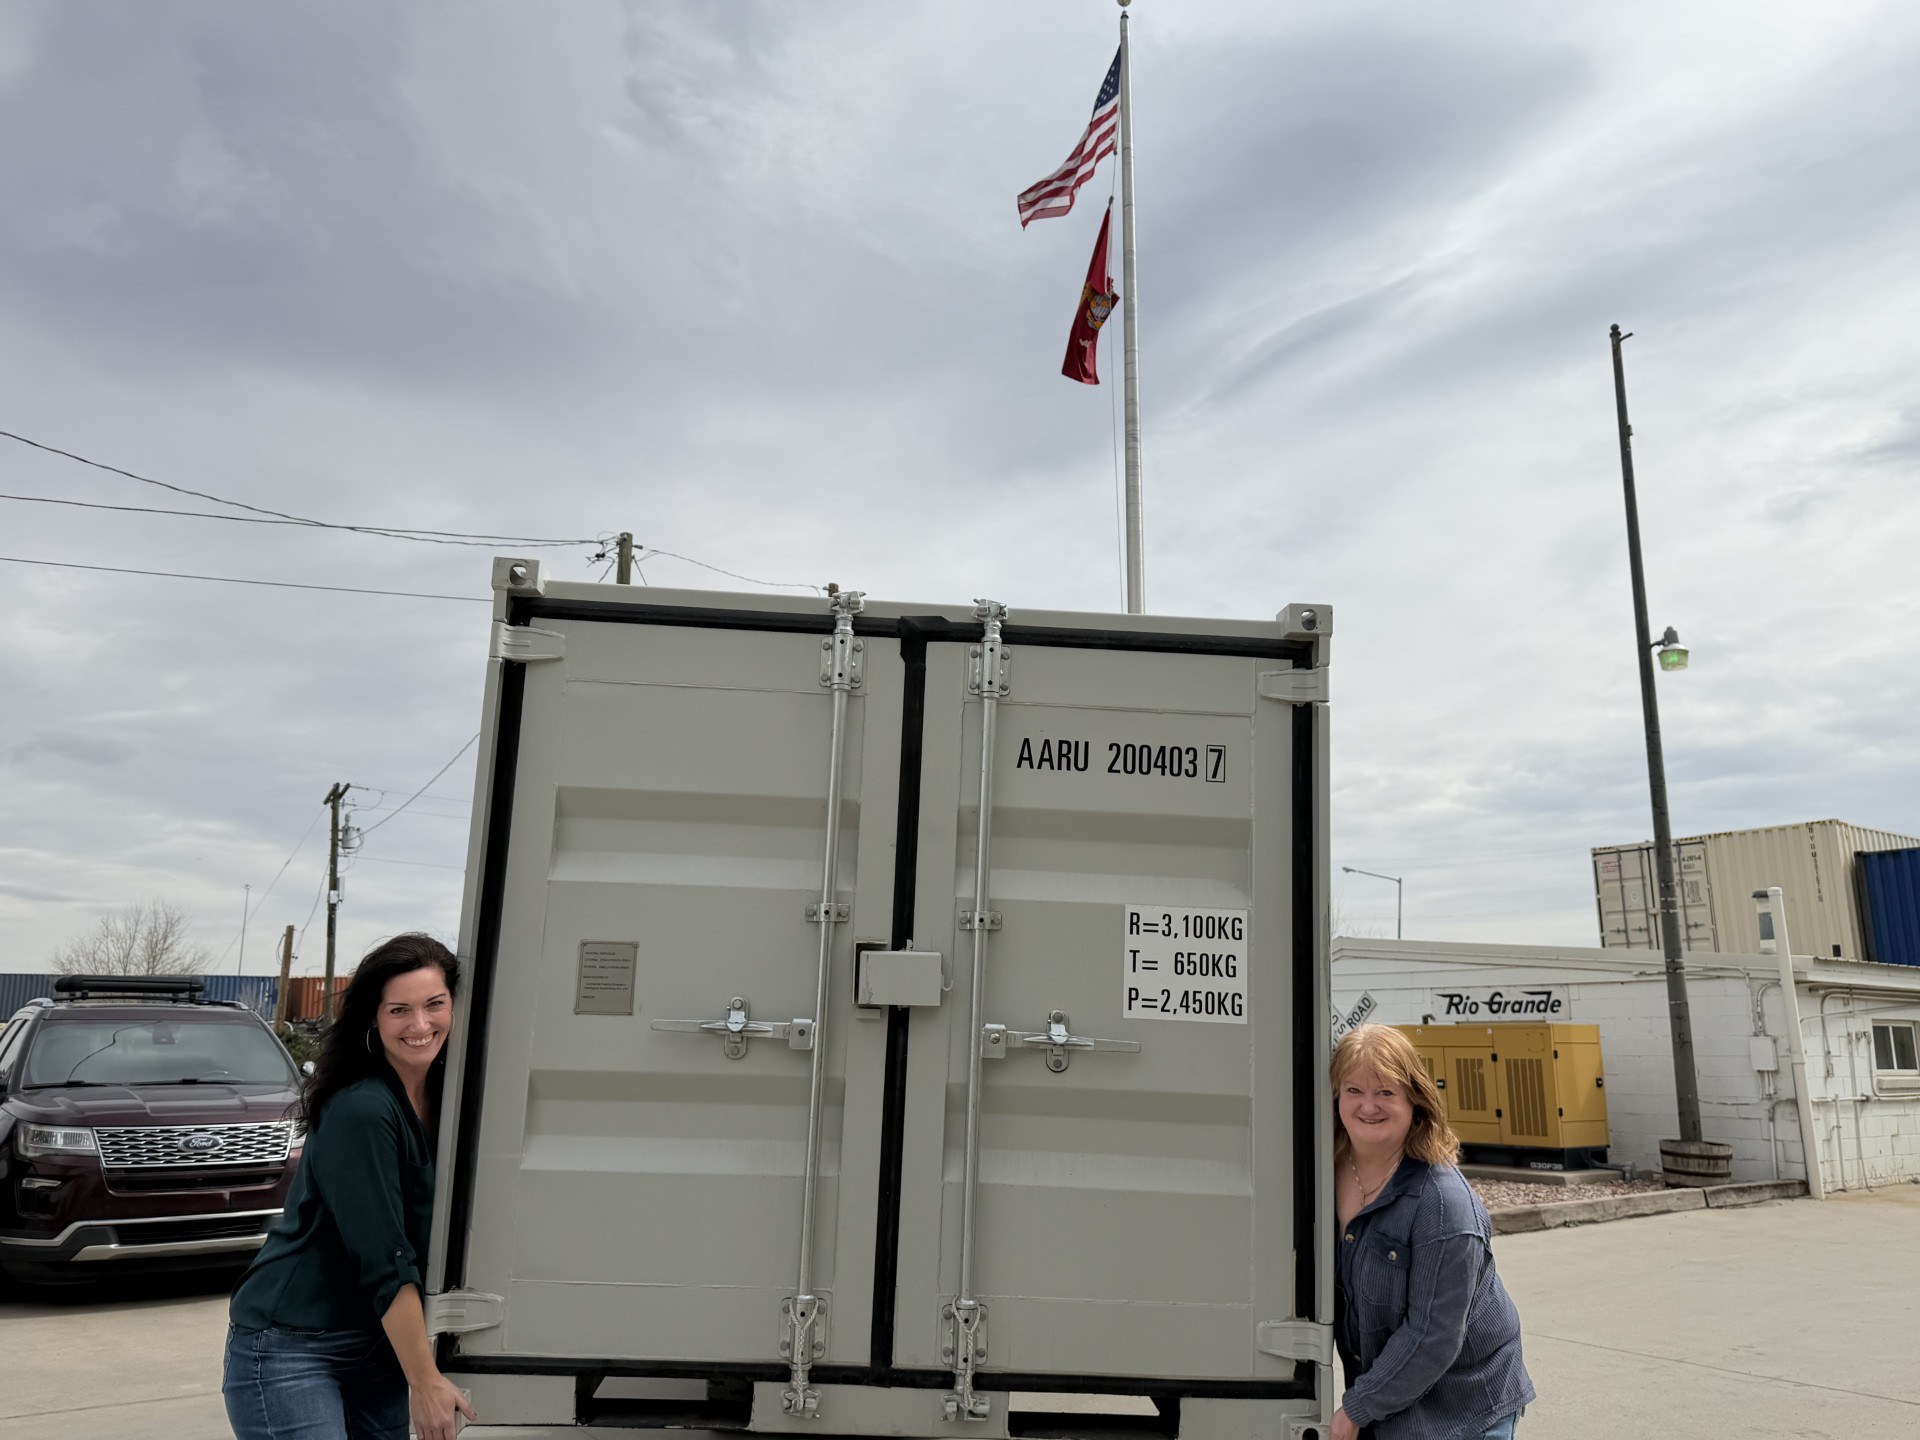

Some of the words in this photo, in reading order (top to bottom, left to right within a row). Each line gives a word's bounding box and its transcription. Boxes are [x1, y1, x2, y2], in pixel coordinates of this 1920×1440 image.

[1016, 737, 1090, 772] AARU
[1107, 742, 1198, 778] 200403
[1208, 747, 1223, 780] 7
[1129, 912, 1243, 941] R=3,100KG
[1129, 949, 1159, 973] T=
[1174, 951, 1237, 978] 650KG
[1128, 987, 1243, 1017] P=2,450KG
[1346, 997, 1372, 1030] ROAD
[1434, 993, 1479, 1015] Rio
[1480, 991, 1562, 1015] Grande
[189, 1137, 213, 1148] Ford
